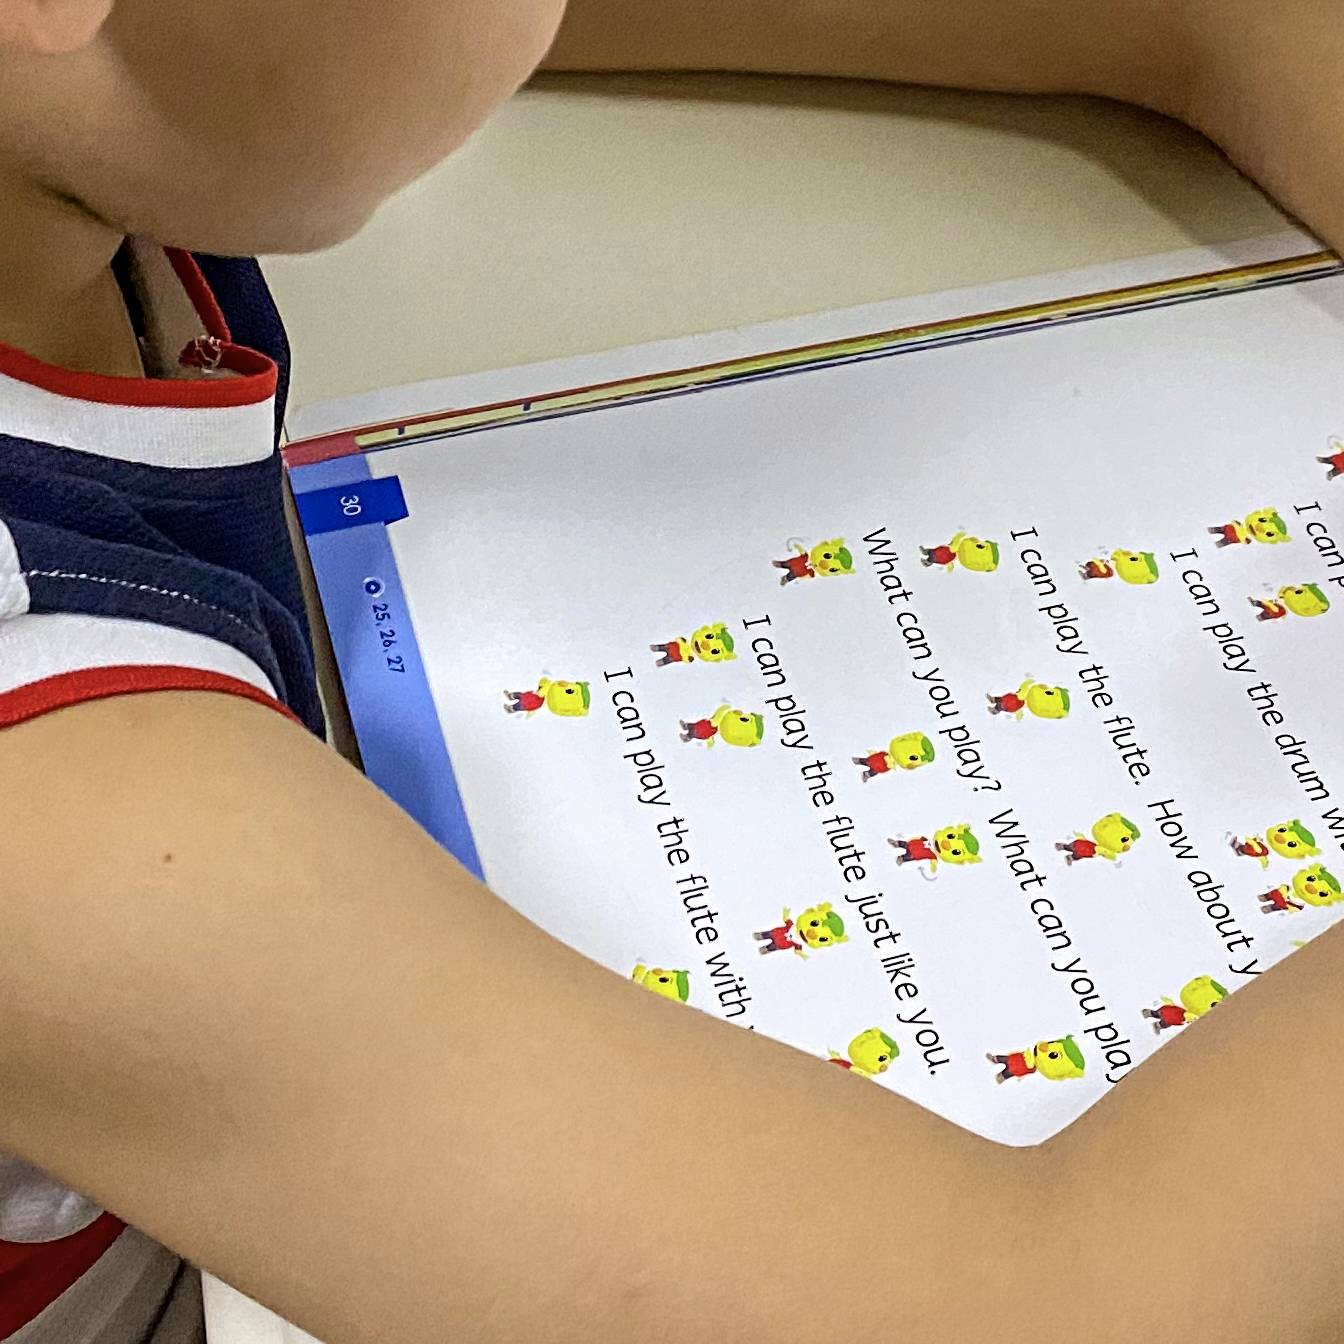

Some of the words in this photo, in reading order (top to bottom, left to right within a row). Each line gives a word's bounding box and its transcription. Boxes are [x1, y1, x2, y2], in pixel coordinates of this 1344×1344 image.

[340, 494, 362, 517] 30
[1293, 501, 1322, 515] I
[1010, 526, 1039, 542] I
[1169, 547, 1199, 562] I
[1306, 522, 1344, 568] can
[862, 526, 914, 605] What
[1020, 548, 1057, 597] can
[1182, 569, 1220, 616] can
[742, 614, 772, 630] I
[896, 612, 932, 661] can
[1038, 603, 1089, 655] play
[1202, 622, 1257, 673] play
[387, 656, 406, 673] 27
[603, 666, 634, 683] I
[751, 637, 787, 688] can
[1078, 663, 1113, 709] the
[611, 690, 646, 742] can
[911, 667, 960, 719] you
[1246, 681, 1284, 727] the
[764, 694, 814, 750] play
[938, 724, 1002, 792] play?
[1103, 715, 1151, 786] flute.
[1274, 734, 1330, 802] drum
[623, 748, 671, 806] play
[800, 759, 835, 808] the
[656, 816, 690, 867] the
[822, 814, 866, 883] flute
[988, 808, 1047, 891] What
[1147, 799, 1199, 859] How
[676, 873, 719, 945] flute
[844, 892, 901, 949] just
[1030, 898, 1072, 951] can
[1187, 870, 1254, 953] about
[705, 951, 752, 1018] with
[880, 952, 919, 1001] like
[1050, 957, 1106, 1016] you
[897, 1007, 950, 1075] you.
